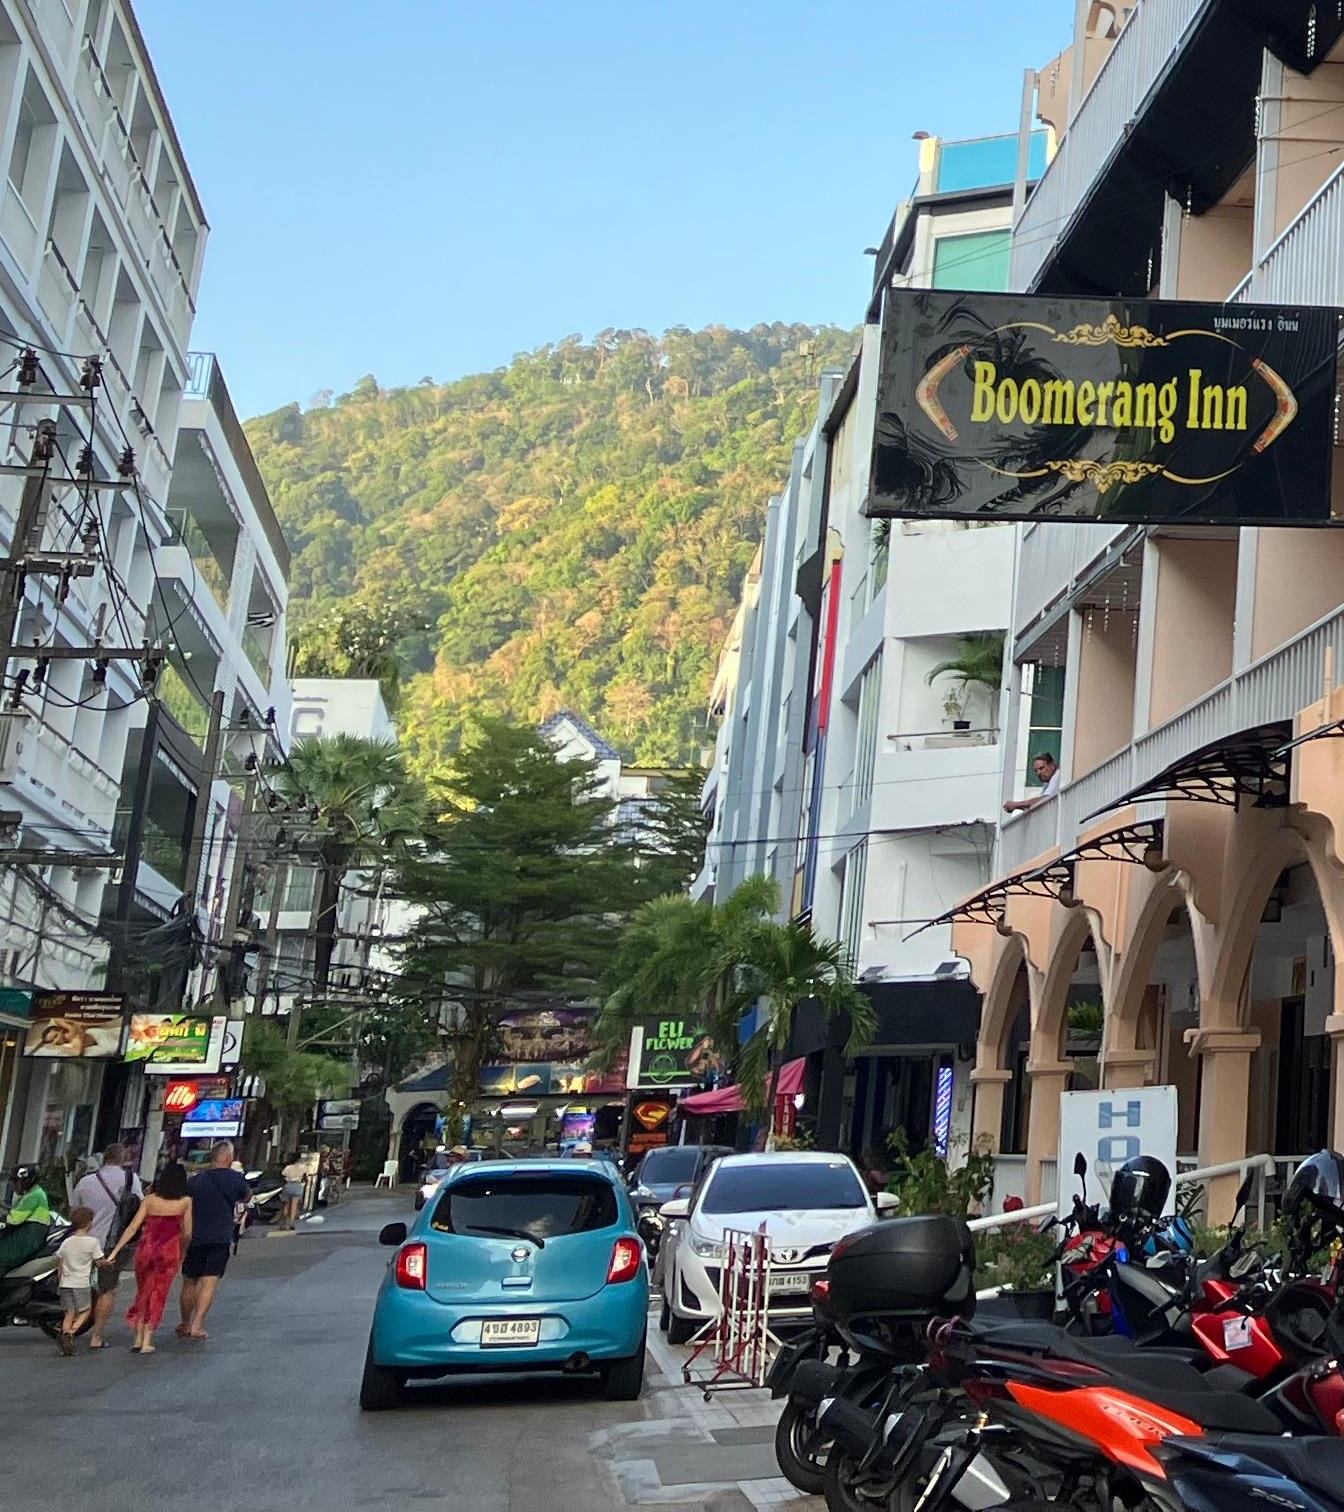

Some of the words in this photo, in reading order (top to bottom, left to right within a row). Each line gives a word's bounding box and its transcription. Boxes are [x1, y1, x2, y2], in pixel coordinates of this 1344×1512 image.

[970, 361, 1178, 444] Boomerang
[1186, 368, 1248, 431] Inn
[658, 1020, 685, 1038] ELI
[645, 1036, 695, 1050] FLOWER
